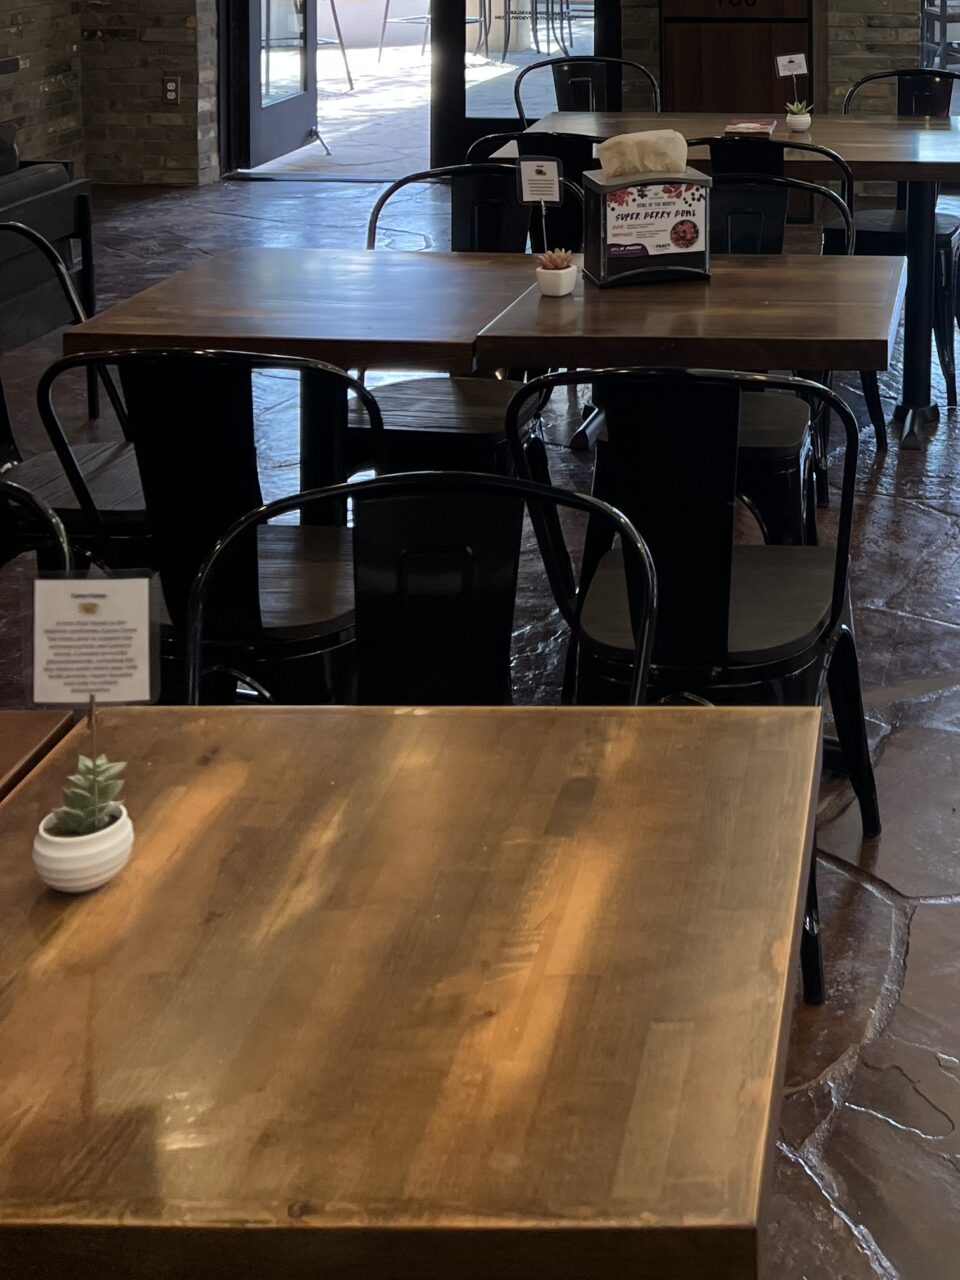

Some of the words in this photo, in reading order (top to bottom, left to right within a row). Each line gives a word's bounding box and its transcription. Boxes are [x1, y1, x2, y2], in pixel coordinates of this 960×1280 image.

[615, 212, 641, 221] SUPER
[644, 210, 671, 220] BERRY
[674, 209, 696, 218] BOWL
